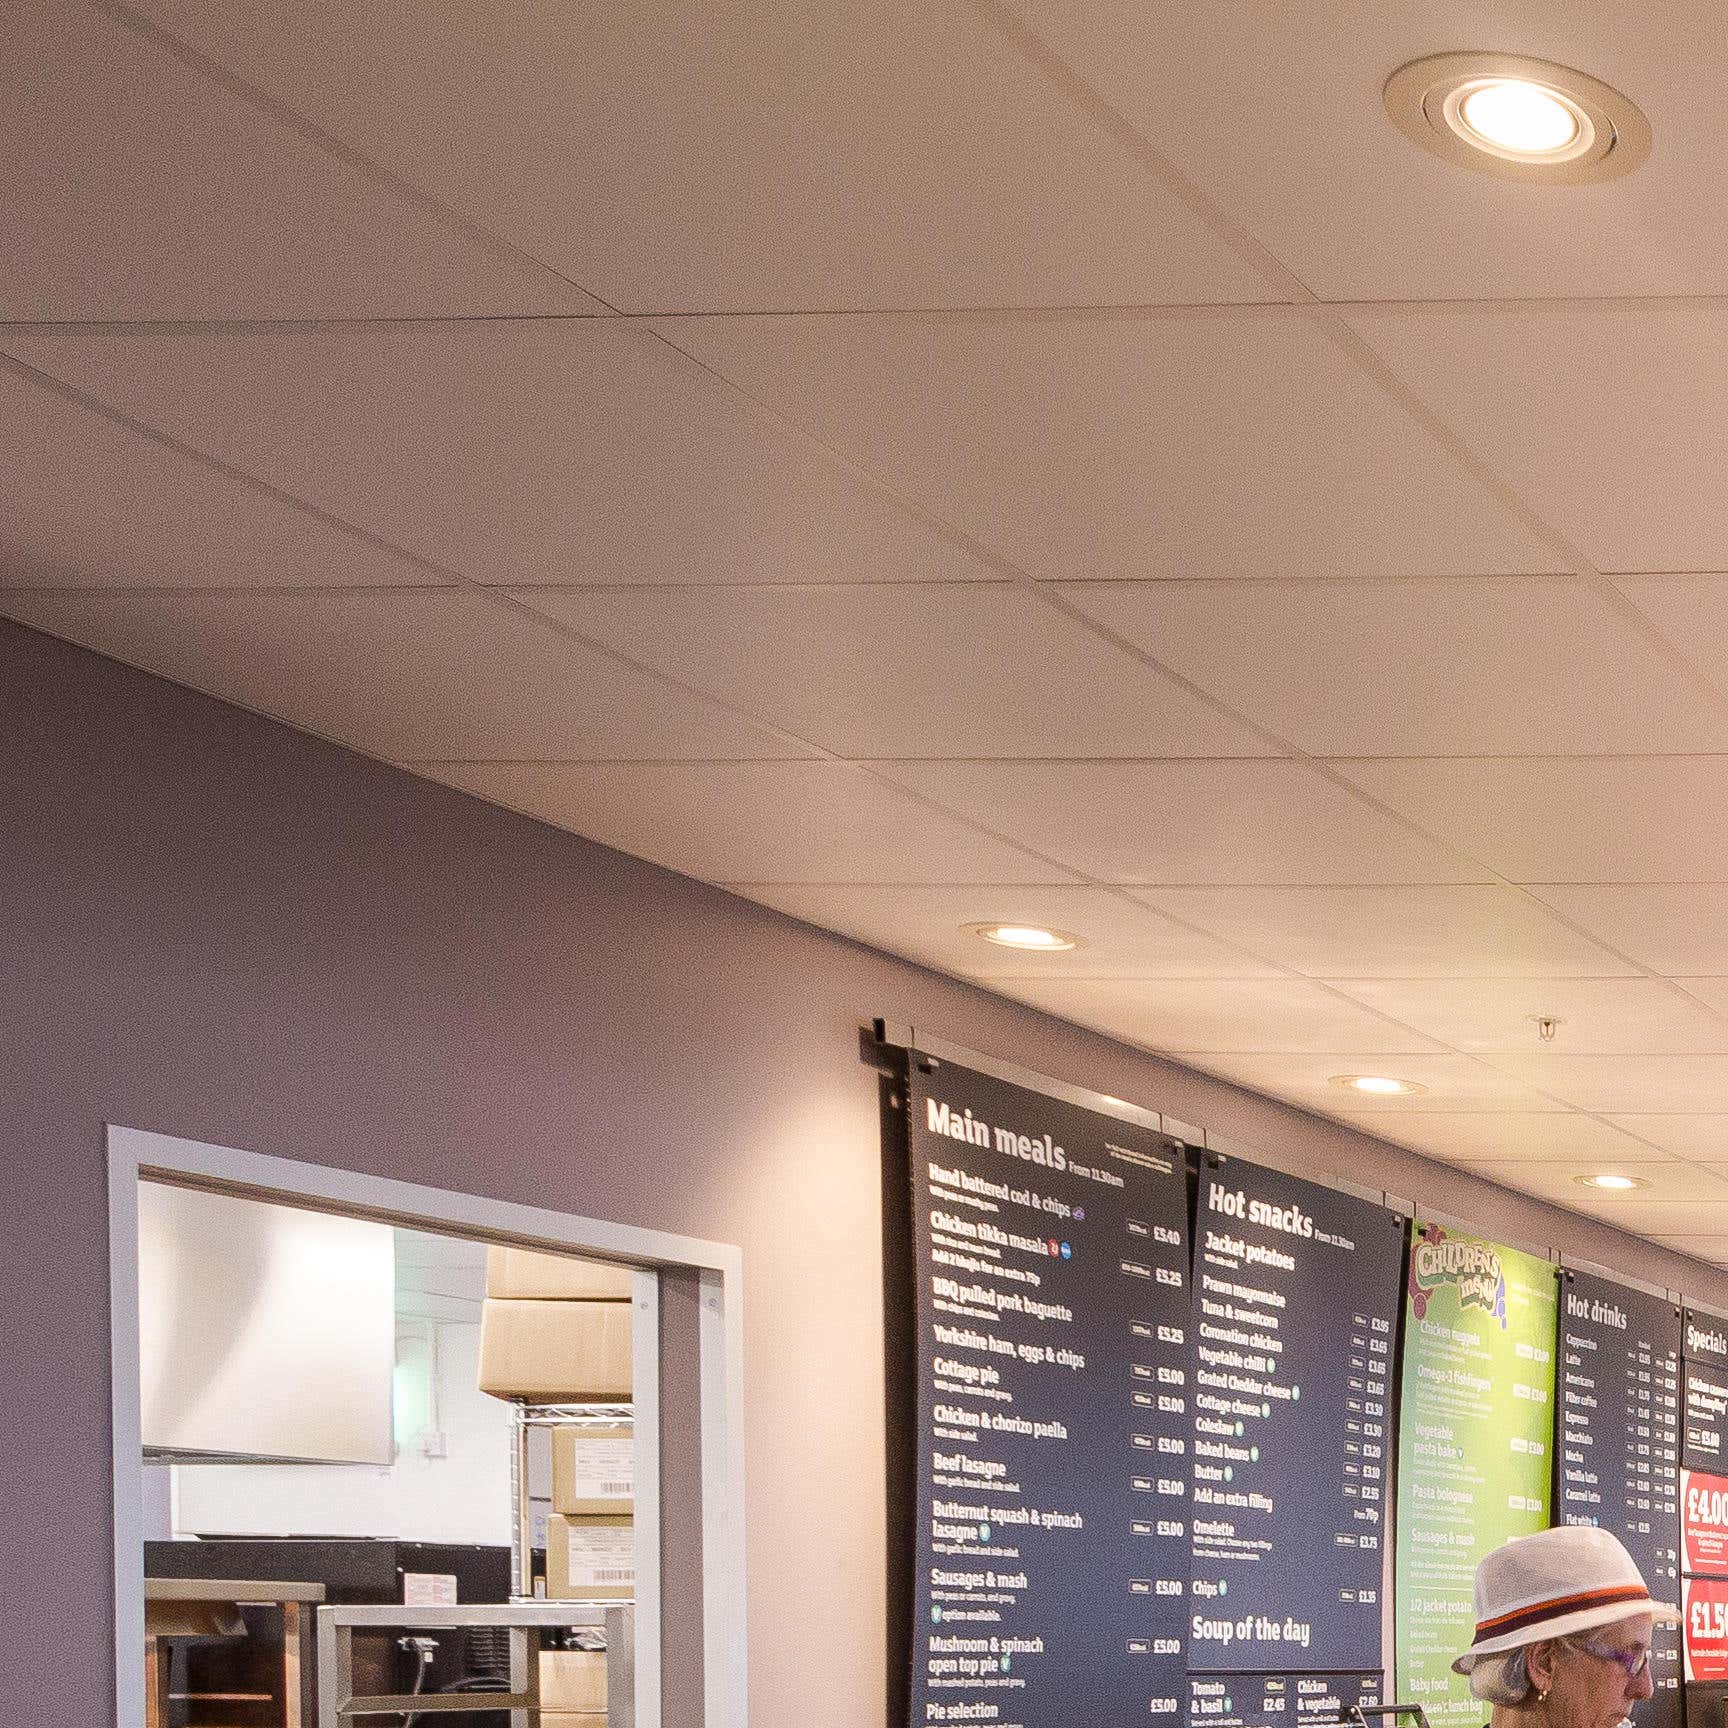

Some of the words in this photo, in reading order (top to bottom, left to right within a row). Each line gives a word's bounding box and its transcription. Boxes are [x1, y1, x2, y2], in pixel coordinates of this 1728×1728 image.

[927, 1097, 989, 1148] Main
[995, 1127, 1067, 1171] meals
[929, 1163, 959, 1184] Hand
[961, 1170, 1009, 1201] battered
[1011, 1185, 1031, 1203] cod
[1032, 1193, 1041, 1208] &
[1043, 1194, 1071, 1219] chips
[1208, 1182, 1246, 1219] Hot
[1249, 1199, 1313, 1239] snacks
[930, 1211, 976, 1239] Chicken
[977, 1224, 1008, 1246] tikka
[1010, 1231, 1049, 1256] masala
[1154, 1226, 1181, 1246] £5.40
[1205, 1231, 1245, 1258] Jacket
[1246, 1244, 1295, 1271] potatoes
[1156, 1268, 1183, 1287] £5.25
[932, 1276, 958, 1300] BBQ
[960, 1283, 996, 1308] pulled
[997, 1293, 1022, 1313] pork
[1024, 1296, 1073, 1322] baguette
[1202, 1275, 1233, 1296] Prawn
[1234, 1283, 1286, 1309] mayonnaise
[1201, 1298, 1225, 1318] Tuna
[1226, 1304, 1233, 1319] &
[1234, 1306, 1279, 1329] sweetcorn
[1567, 1293, 1589, 1320] Hot
[1590, 1300, 1628, 1330] drinks
[1157, 1326, 1184, 1344] £5.25
[1199, 1322, 1248, 1346] Coronation
[1249, 1332, 1283, 1353] chicken
[1420, 1320, 1451, 1337] Chicken
[933, 1325, 988, 1350] Yorkshire
[1018, 1344, 1044, 1364] eggs
[1045, 1348, 1055, 1363] &
[1057, 1348, 1085, 1370] chips
[1687, 1324, 1728, 1356] Specials
[1198, 1346, 1243, 1369] Vegetable
[1243, 1354, 1266, 1373] chilli
[933, 1357, 979, 1383] Cottage
[980, 1366, 1000, 1386] pie
[1158, 1367, 1185, 1386] £5.00
[1197, 1370, 1227, 1389] Grated
[1228, 1374, 1263, 1395] Cheddar
[1264, 1381, 1291, 1400] cheese
[1158, 1396, 1185, 1414] £5.00
[1196, 1394, 1231, 1414] Cottage
[1232, 1400, 1261, 1418] cheese
[933, 1404, 979, 1428] Chicken
[981, 1412, 991, 1428] &
[992, 1413, 1033, 1435] chorizo
[1034, 1421, 1068, 1440] paella
[1195, 1417, 1235, 1436] Coleslaw
[1158, 1437, 1185, 1455] £5.00
[1195, 1440, 1223, 1457] Baked
[1224, 1444, 1250, 1462] beans
[1413, 1442, 1437, 1457] pasta
[933, 1452, 960, 1472] Beef
[962, 1455, 1006, 1478] lasagne
[1194, 1464, 1223, 1481] Butter
[1157, 1478, 1184, 1496] £5.00
[1411, 1484, 1435, 1499] Pasta
[1194, 1488, 1214, 1505] Add
[1214, 1492, 1225, 1505] an
[1226, 1492, 1248, 1507] extra
[1248, 1492, 1274, 1514] filling
[933, 1500, 989, 1522] Butternut
[991, 1506, 1029, 1527] squash
[1031, 1510, 1040, 1525] &
[1041, 1510, 1083, 1531] spinach
[933, 1520, 978, 1544] lasagne
[1157, 1520, 1184, 1538] £5.00
[1193, 1519, 1235, 1537] Omelette
[1411, 1528, 1448, 1547] Sausages
[931, 1568, 985, 1593] Sausages
[985, 1571, 996, 1588] &
[997, 1572, 1028, 1589] mash
[1155, 1580, 1183, 1596] £5.00
[1192, 1580, 1218, 1599] Chips
[1423, 1599, 1447, 1615] jacket
[1193, 1615, 1234, 1646] Soup
[1236, 1615, 1253, 1641] of
[1255, 1617, 1281, 1641] the
[1282, 1617, 1311, 1648] day
[929, 1636, 988, 1654] Mushroom
[989, 1636, 999, 1652] &
[1000, 1636, 1044, 1657] spinach
[1153, 1639, 1181, 1655] £5.00
[929, 1659, 957, 1676] open
[958, 1657, 978, 1676] top
[979, 1655, 998, 1676] pie
[1192, 1681, 1226, 1696] Tomato
[1297, 1680, 1328, 1694] Chicken
[1410, 1678, 1431, 1694] Baby
[1431, 1678, 1449, 1692] food
[926, 1703, 946, 1720] Pie
[947, 1701, 999, 1720] selection
[1150, 1698, 1178, 1714] £5.00
[1191, 1698, 1200, 1713] &
[1201, 1697, 1223, 1714] basil
[1297, 1697, 1306, 1711] &
[1306, 1697, 1341, 1714] vegetable
